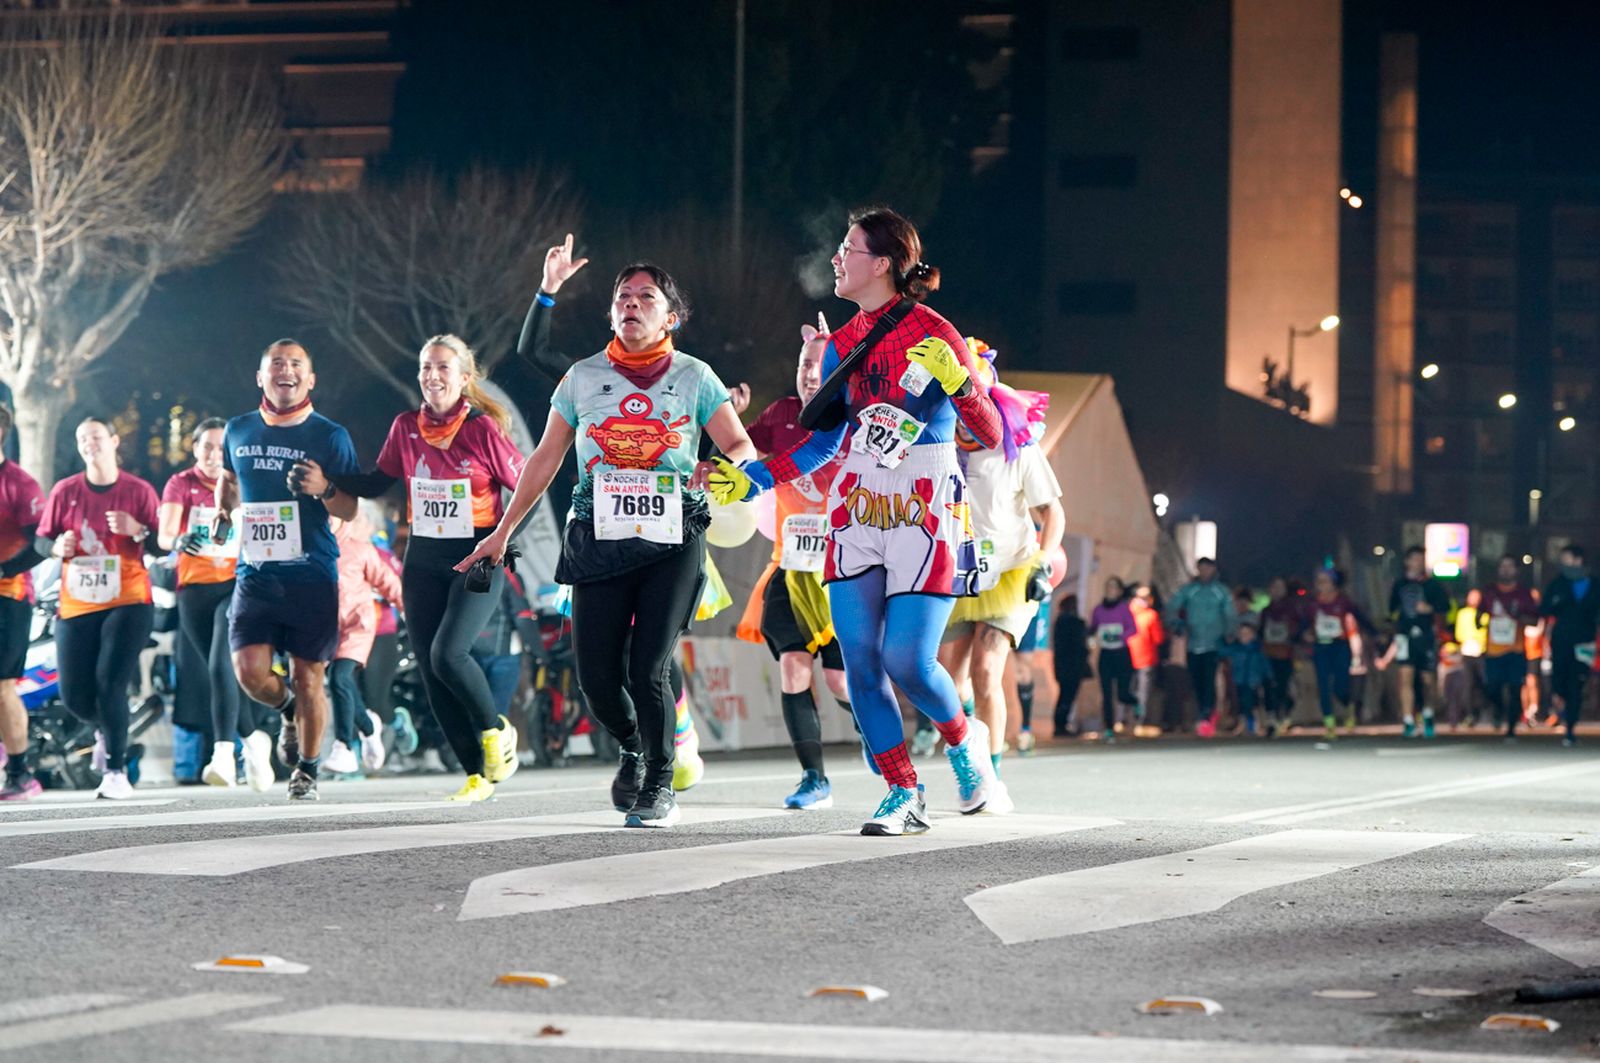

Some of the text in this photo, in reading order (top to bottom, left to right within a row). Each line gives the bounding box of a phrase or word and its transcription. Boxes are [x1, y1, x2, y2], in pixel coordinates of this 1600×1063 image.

[266, 445, 306, 460] RURAL
[253, 458, 285, 471] JAÉN
[613, 475, 649, 484] NOCHE DE
[797, 477, 812, 493] 43
[603, 485, 620, 493] SAN
[423, 500, 458, 518] 2072
[611, 494, 665, 517] 7689
[252, 523, 286, 541] 2073
[80, 574, 107, 587] 7574
